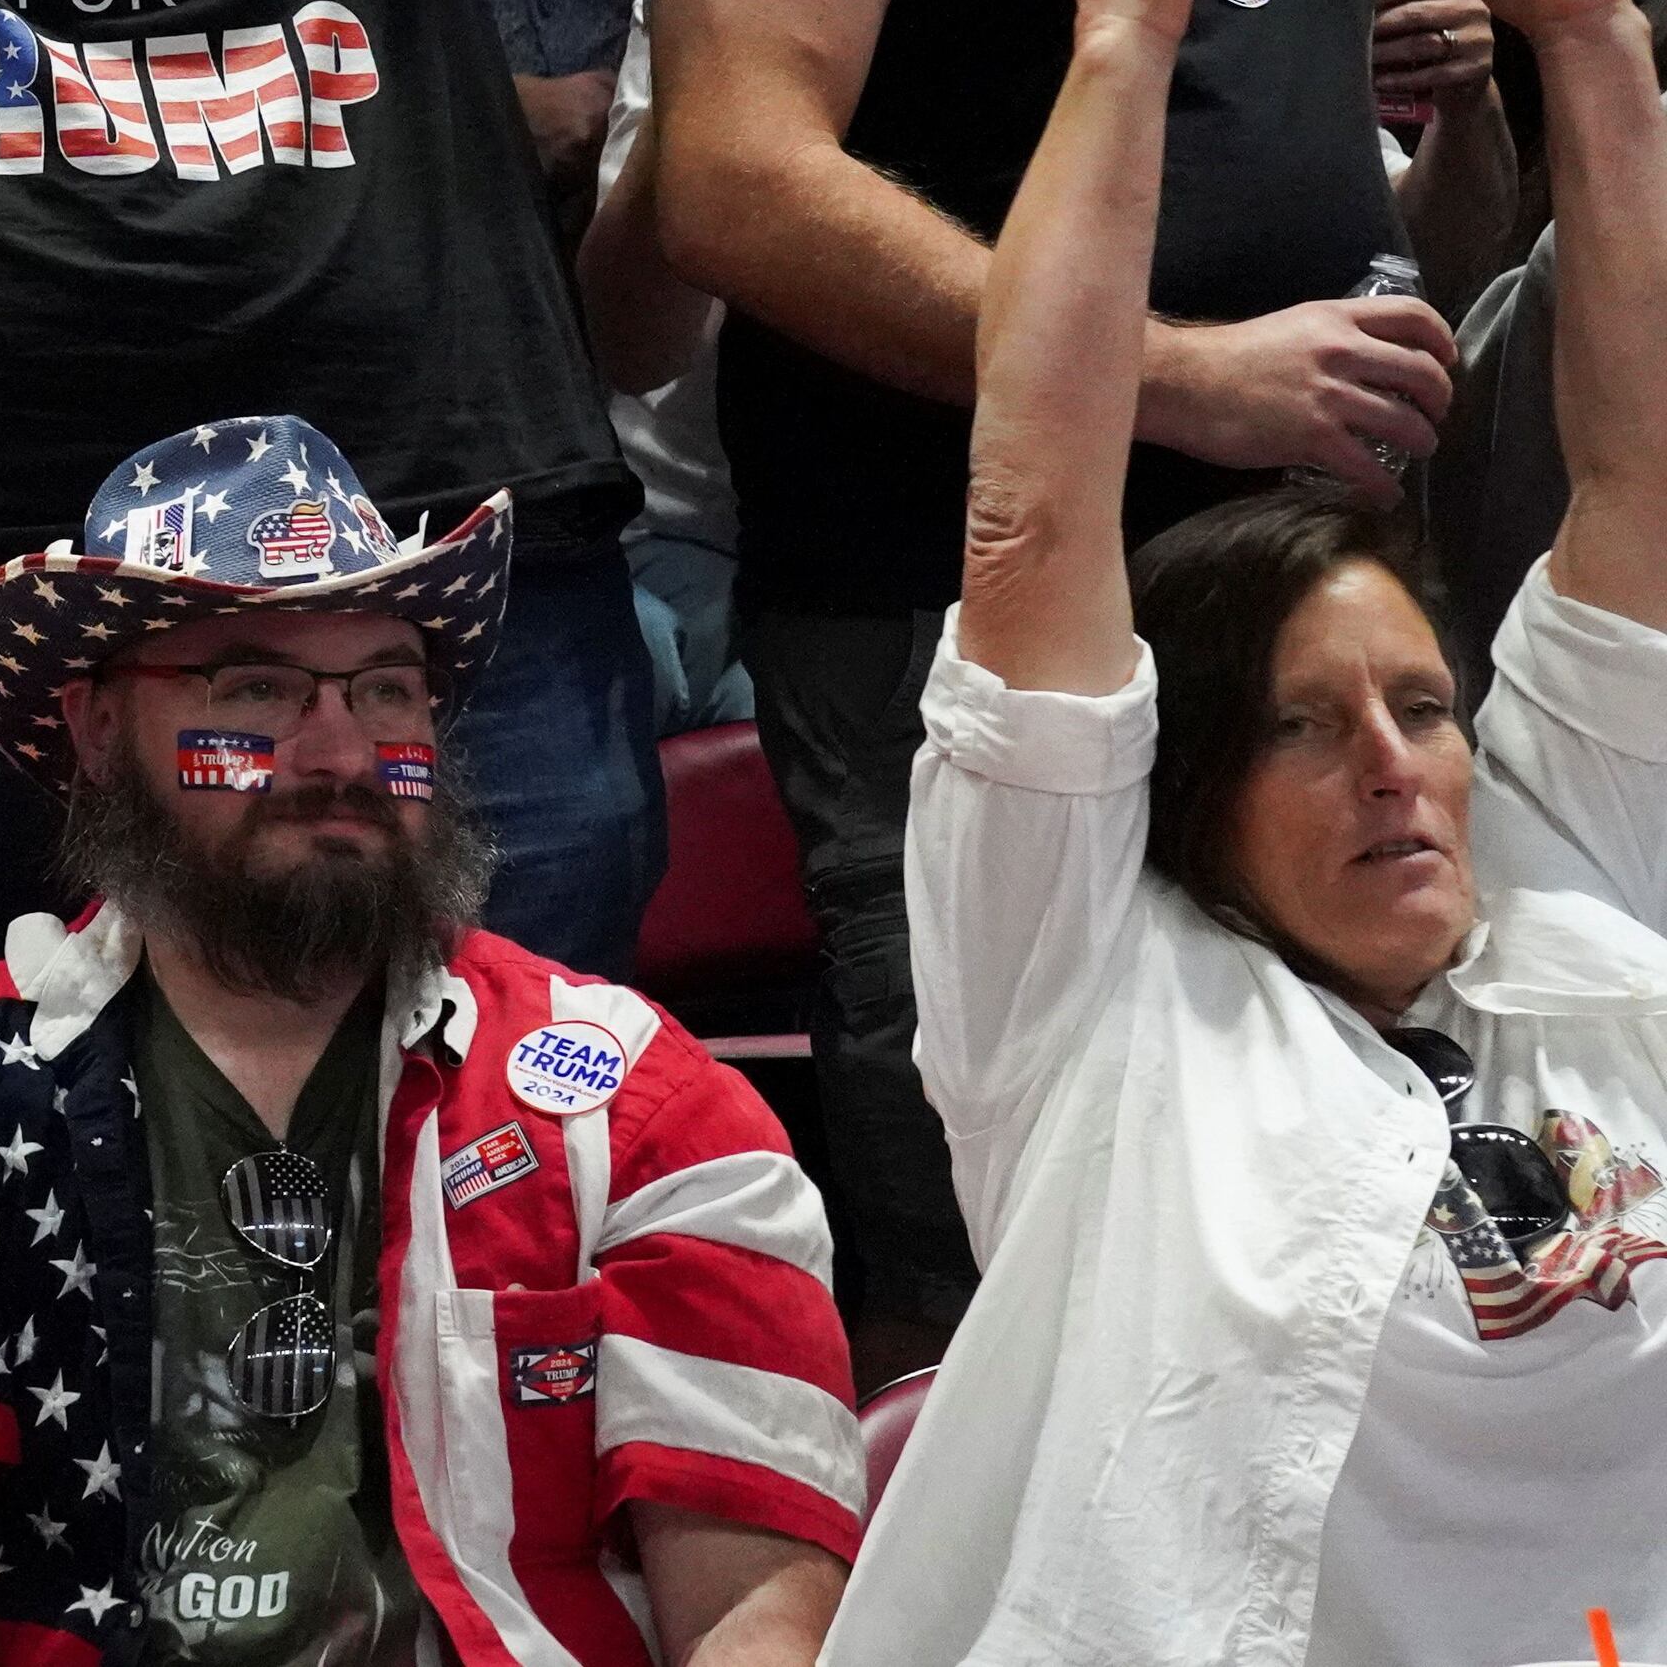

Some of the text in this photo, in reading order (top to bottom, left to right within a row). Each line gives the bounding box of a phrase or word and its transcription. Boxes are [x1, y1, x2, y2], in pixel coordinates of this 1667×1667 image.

[201, 752, 246, 767] TRUMP
[538, 1030, 622, 1073] TEAM
[517, 1043, 619, 1091] TRUMP
[523, 1080, 575, 1106] 2024
[448, 1160, 483, 1187] TRUMP
[544, 1366, 580, 1382] TRUMP
[550, 1357, 572, 1369] 2024
[178, 1570, 290, 1619] GOD
